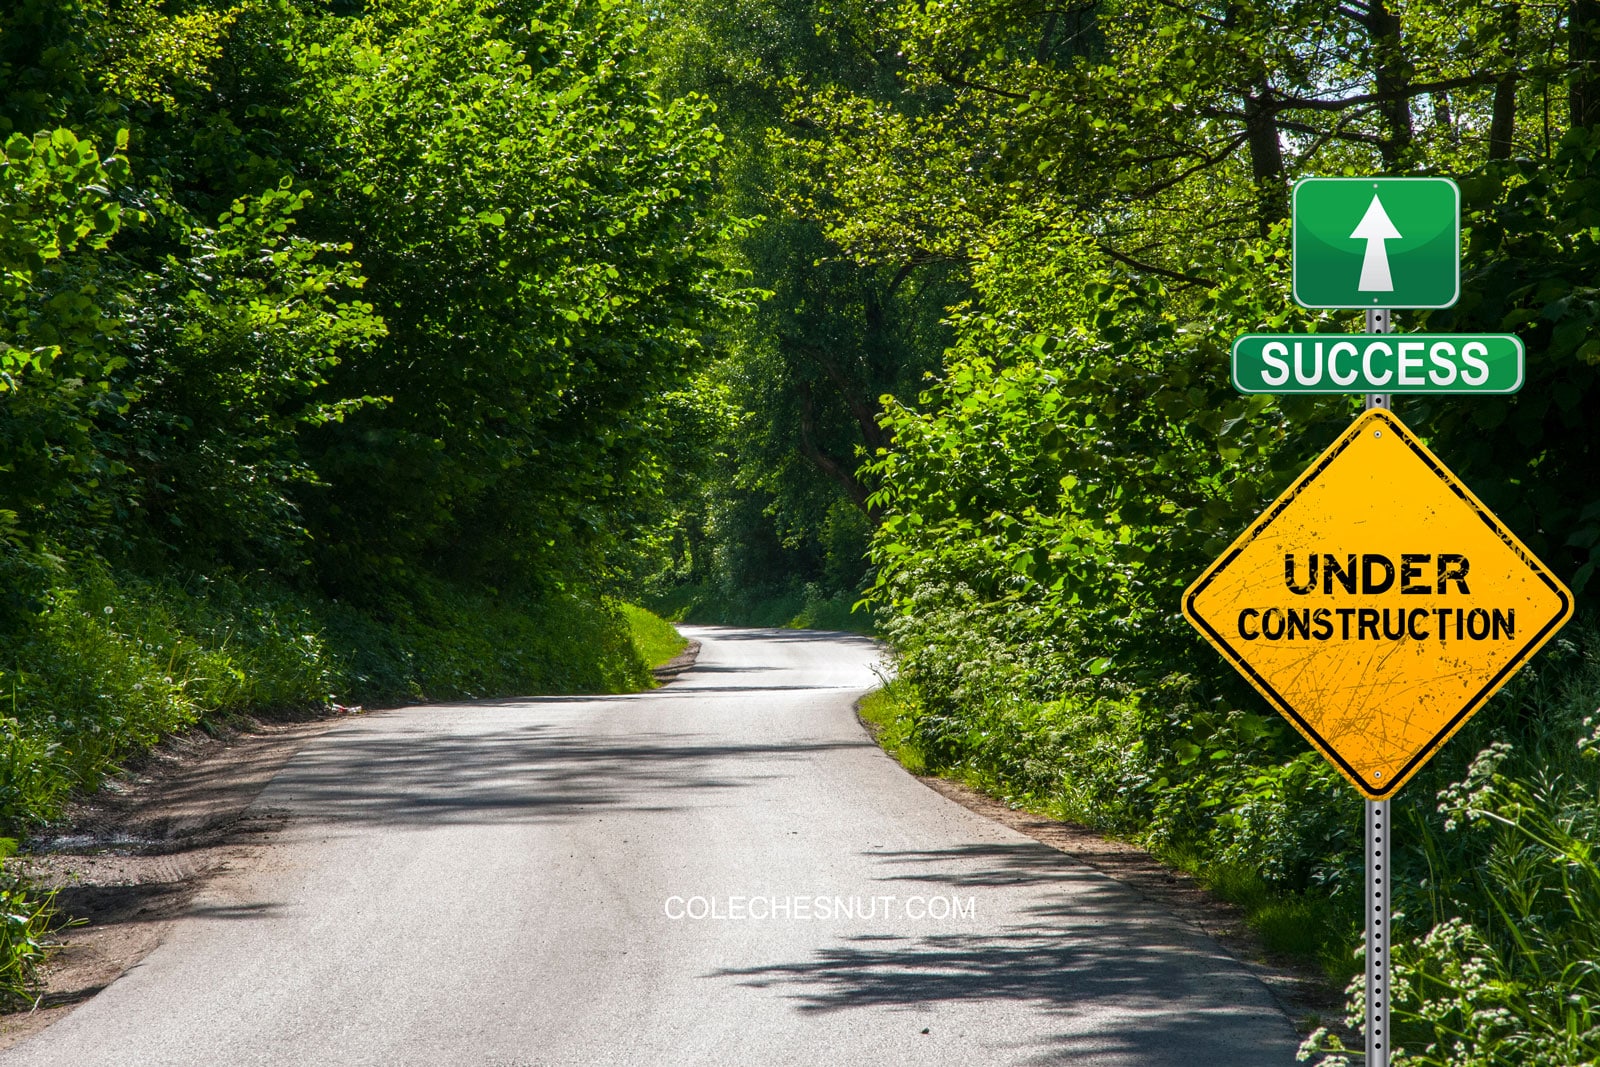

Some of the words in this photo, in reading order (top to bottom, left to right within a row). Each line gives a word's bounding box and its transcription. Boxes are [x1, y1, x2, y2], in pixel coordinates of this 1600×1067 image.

[1261, 341, 1489, 387] SUCCESS
[1284, 553, 1471, 596] UNDER
[1237, 607, 1515, 641] CONSTRUCTION
